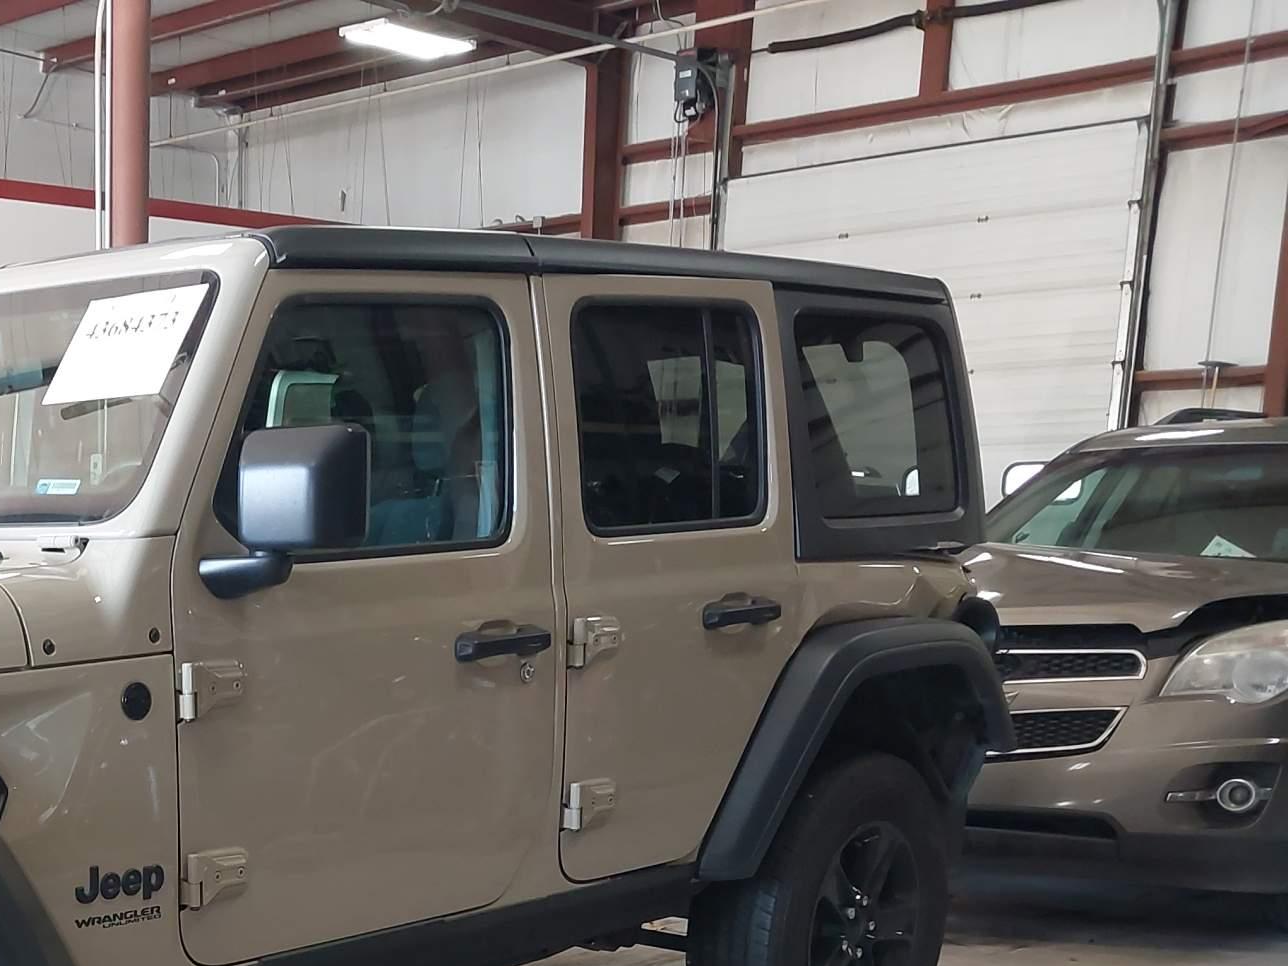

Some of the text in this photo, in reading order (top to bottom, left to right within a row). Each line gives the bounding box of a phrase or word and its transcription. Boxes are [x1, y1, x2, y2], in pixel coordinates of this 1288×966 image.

[85, 310, 180, 340] 43684373
[74, 864, 165, 905] Jeep
[74, 905, 162, 929] WRANGLER
[102, 912, 162, 929] UNLIMITED
